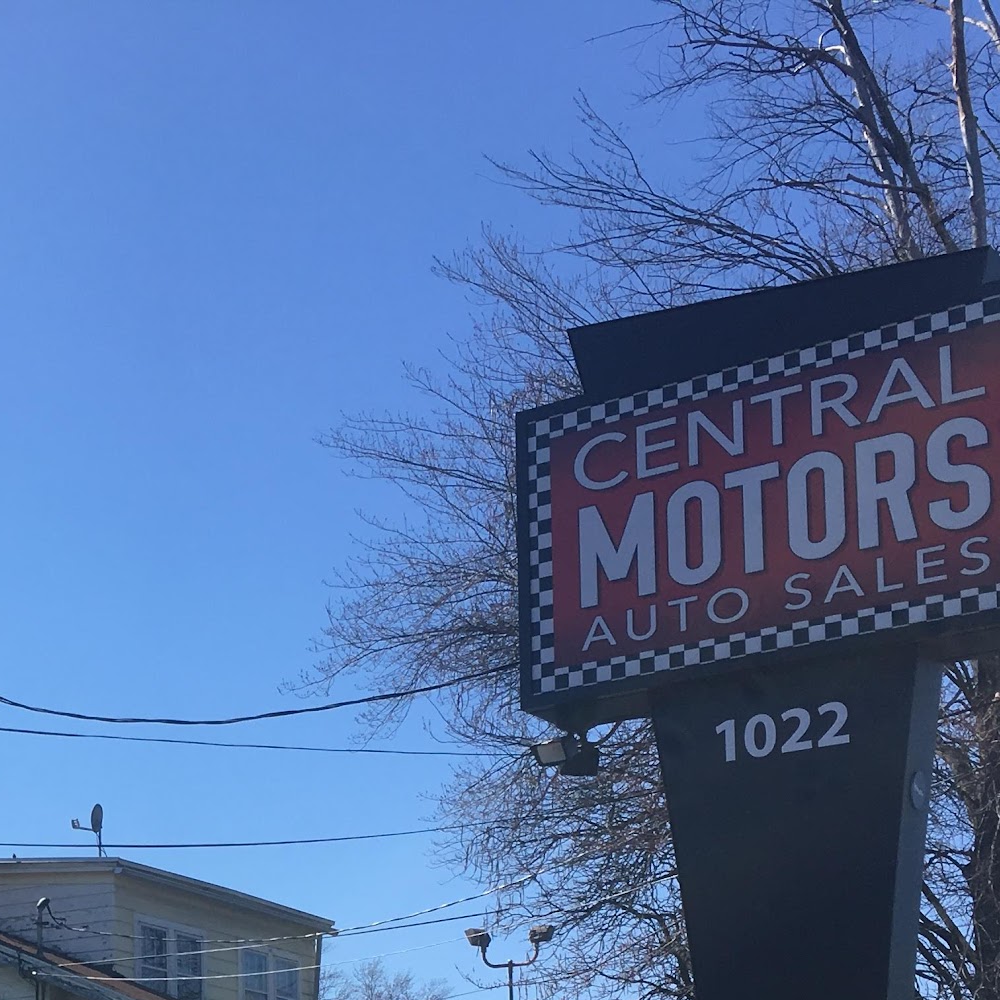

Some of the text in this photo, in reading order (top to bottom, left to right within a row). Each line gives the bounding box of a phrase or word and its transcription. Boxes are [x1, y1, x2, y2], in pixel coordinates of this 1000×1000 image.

[573, 345, 986, 490] CENTRAL
[578, 417, 991, 609] MOTORS
[581, 536, 991, 652] AUTO SALES
[715, 701, 851, 762] 1022
